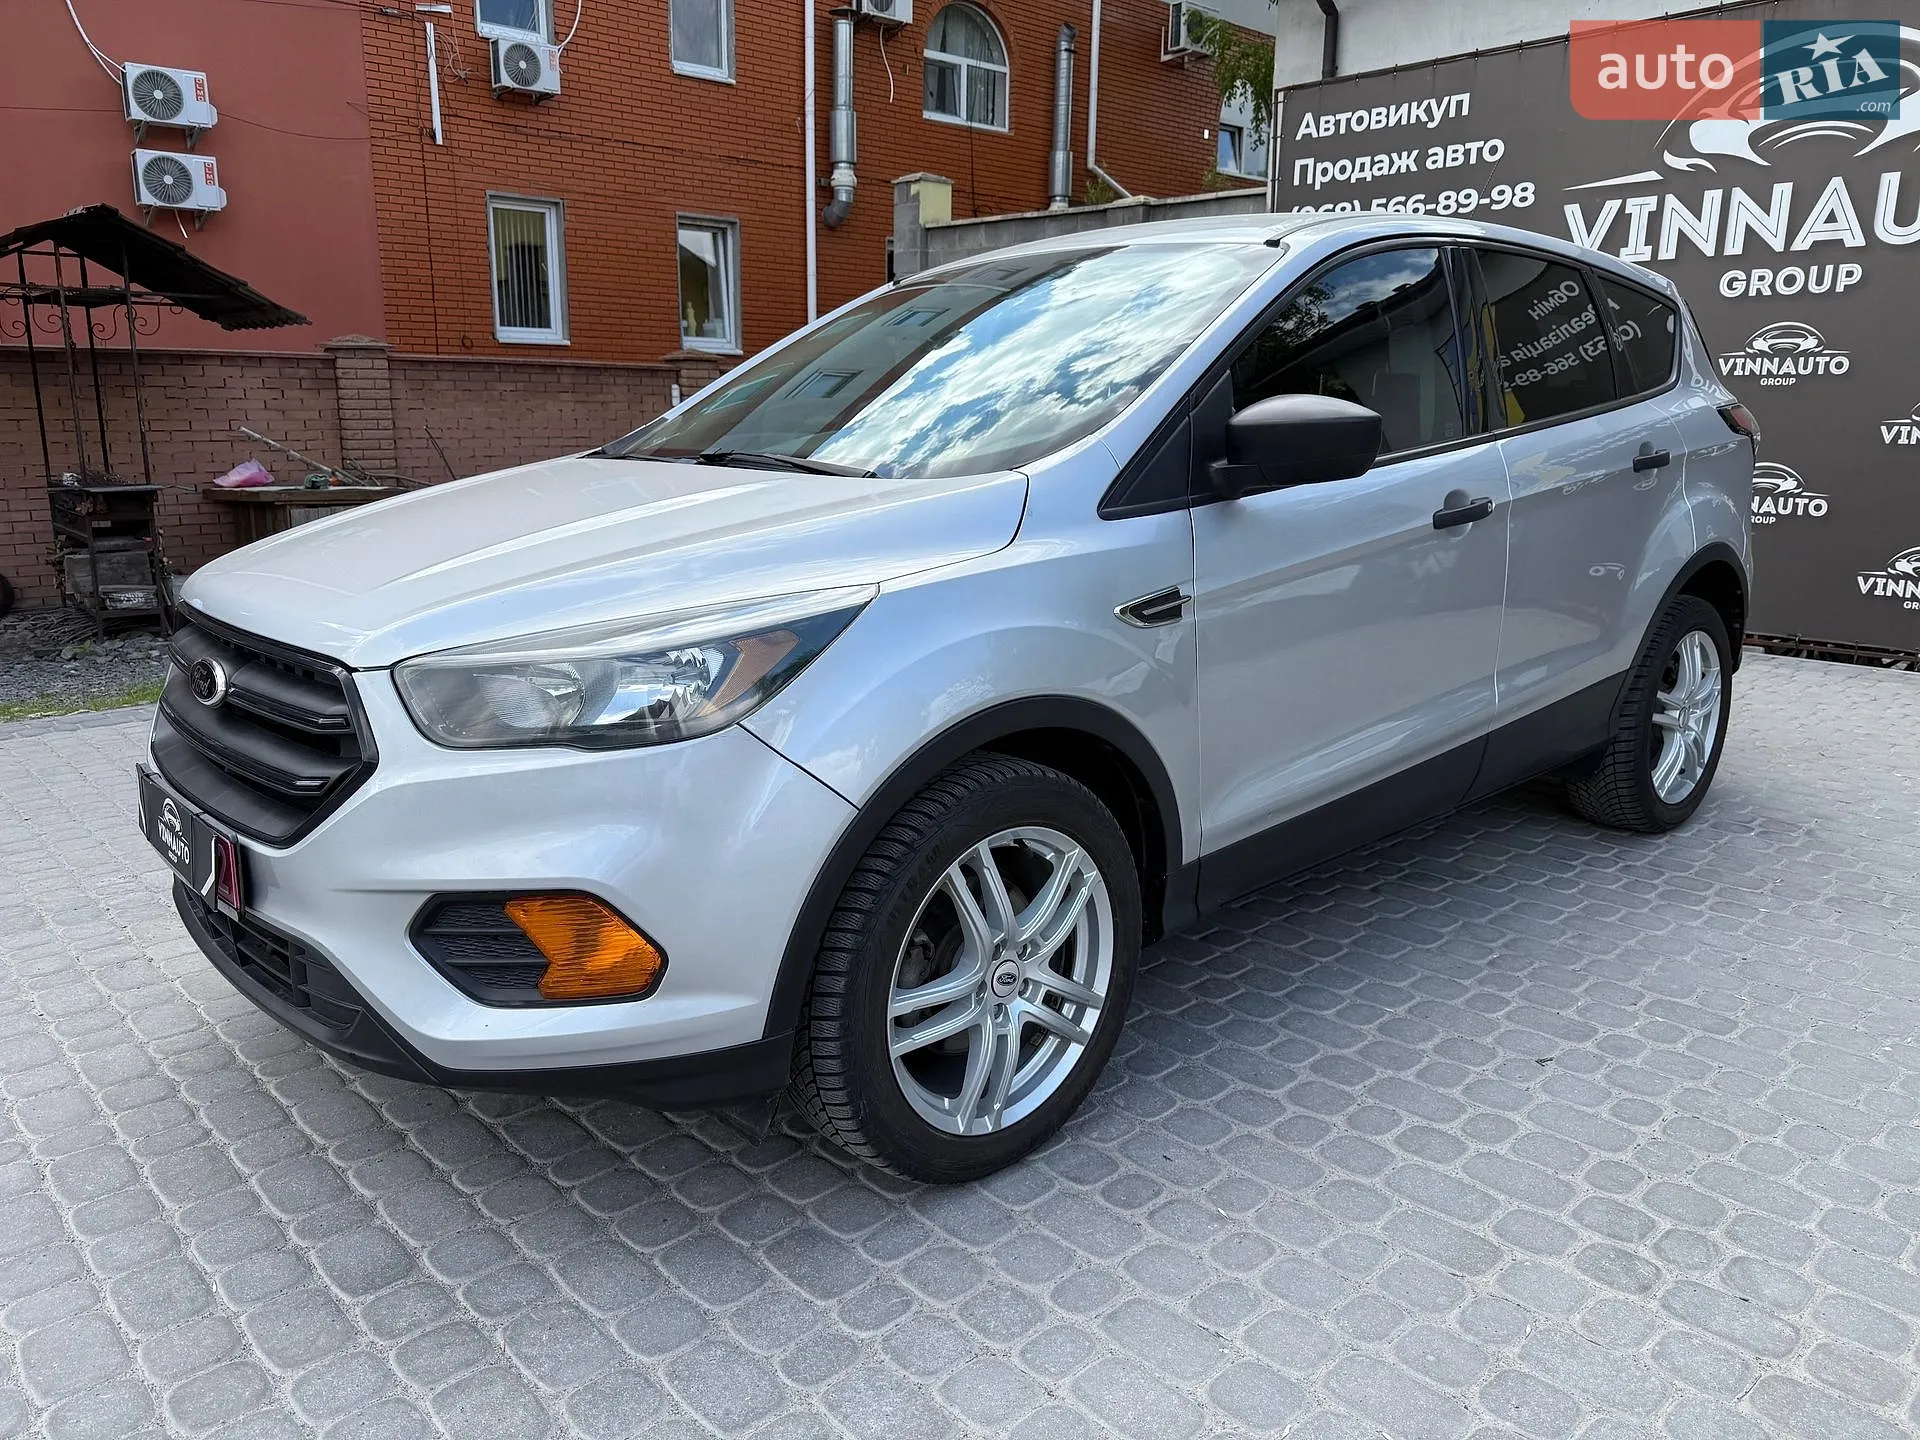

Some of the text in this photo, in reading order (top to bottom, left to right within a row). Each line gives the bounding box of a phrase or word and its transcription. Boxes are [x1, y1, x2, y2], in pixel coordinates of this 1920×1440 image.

[1295, 93, 1471, 141] Автовикуп
[1293, 138, 1505, 190] Продаж авто
[1370, 181, 1535, 215] 566-89-98
[1719, 263, 1863, 298] GROUP
[1718, 355, 1850, 377] VINNAUTO
[1760, 378, 1797, 387] GROUP
[998, 974, 1016, 984] Ford
